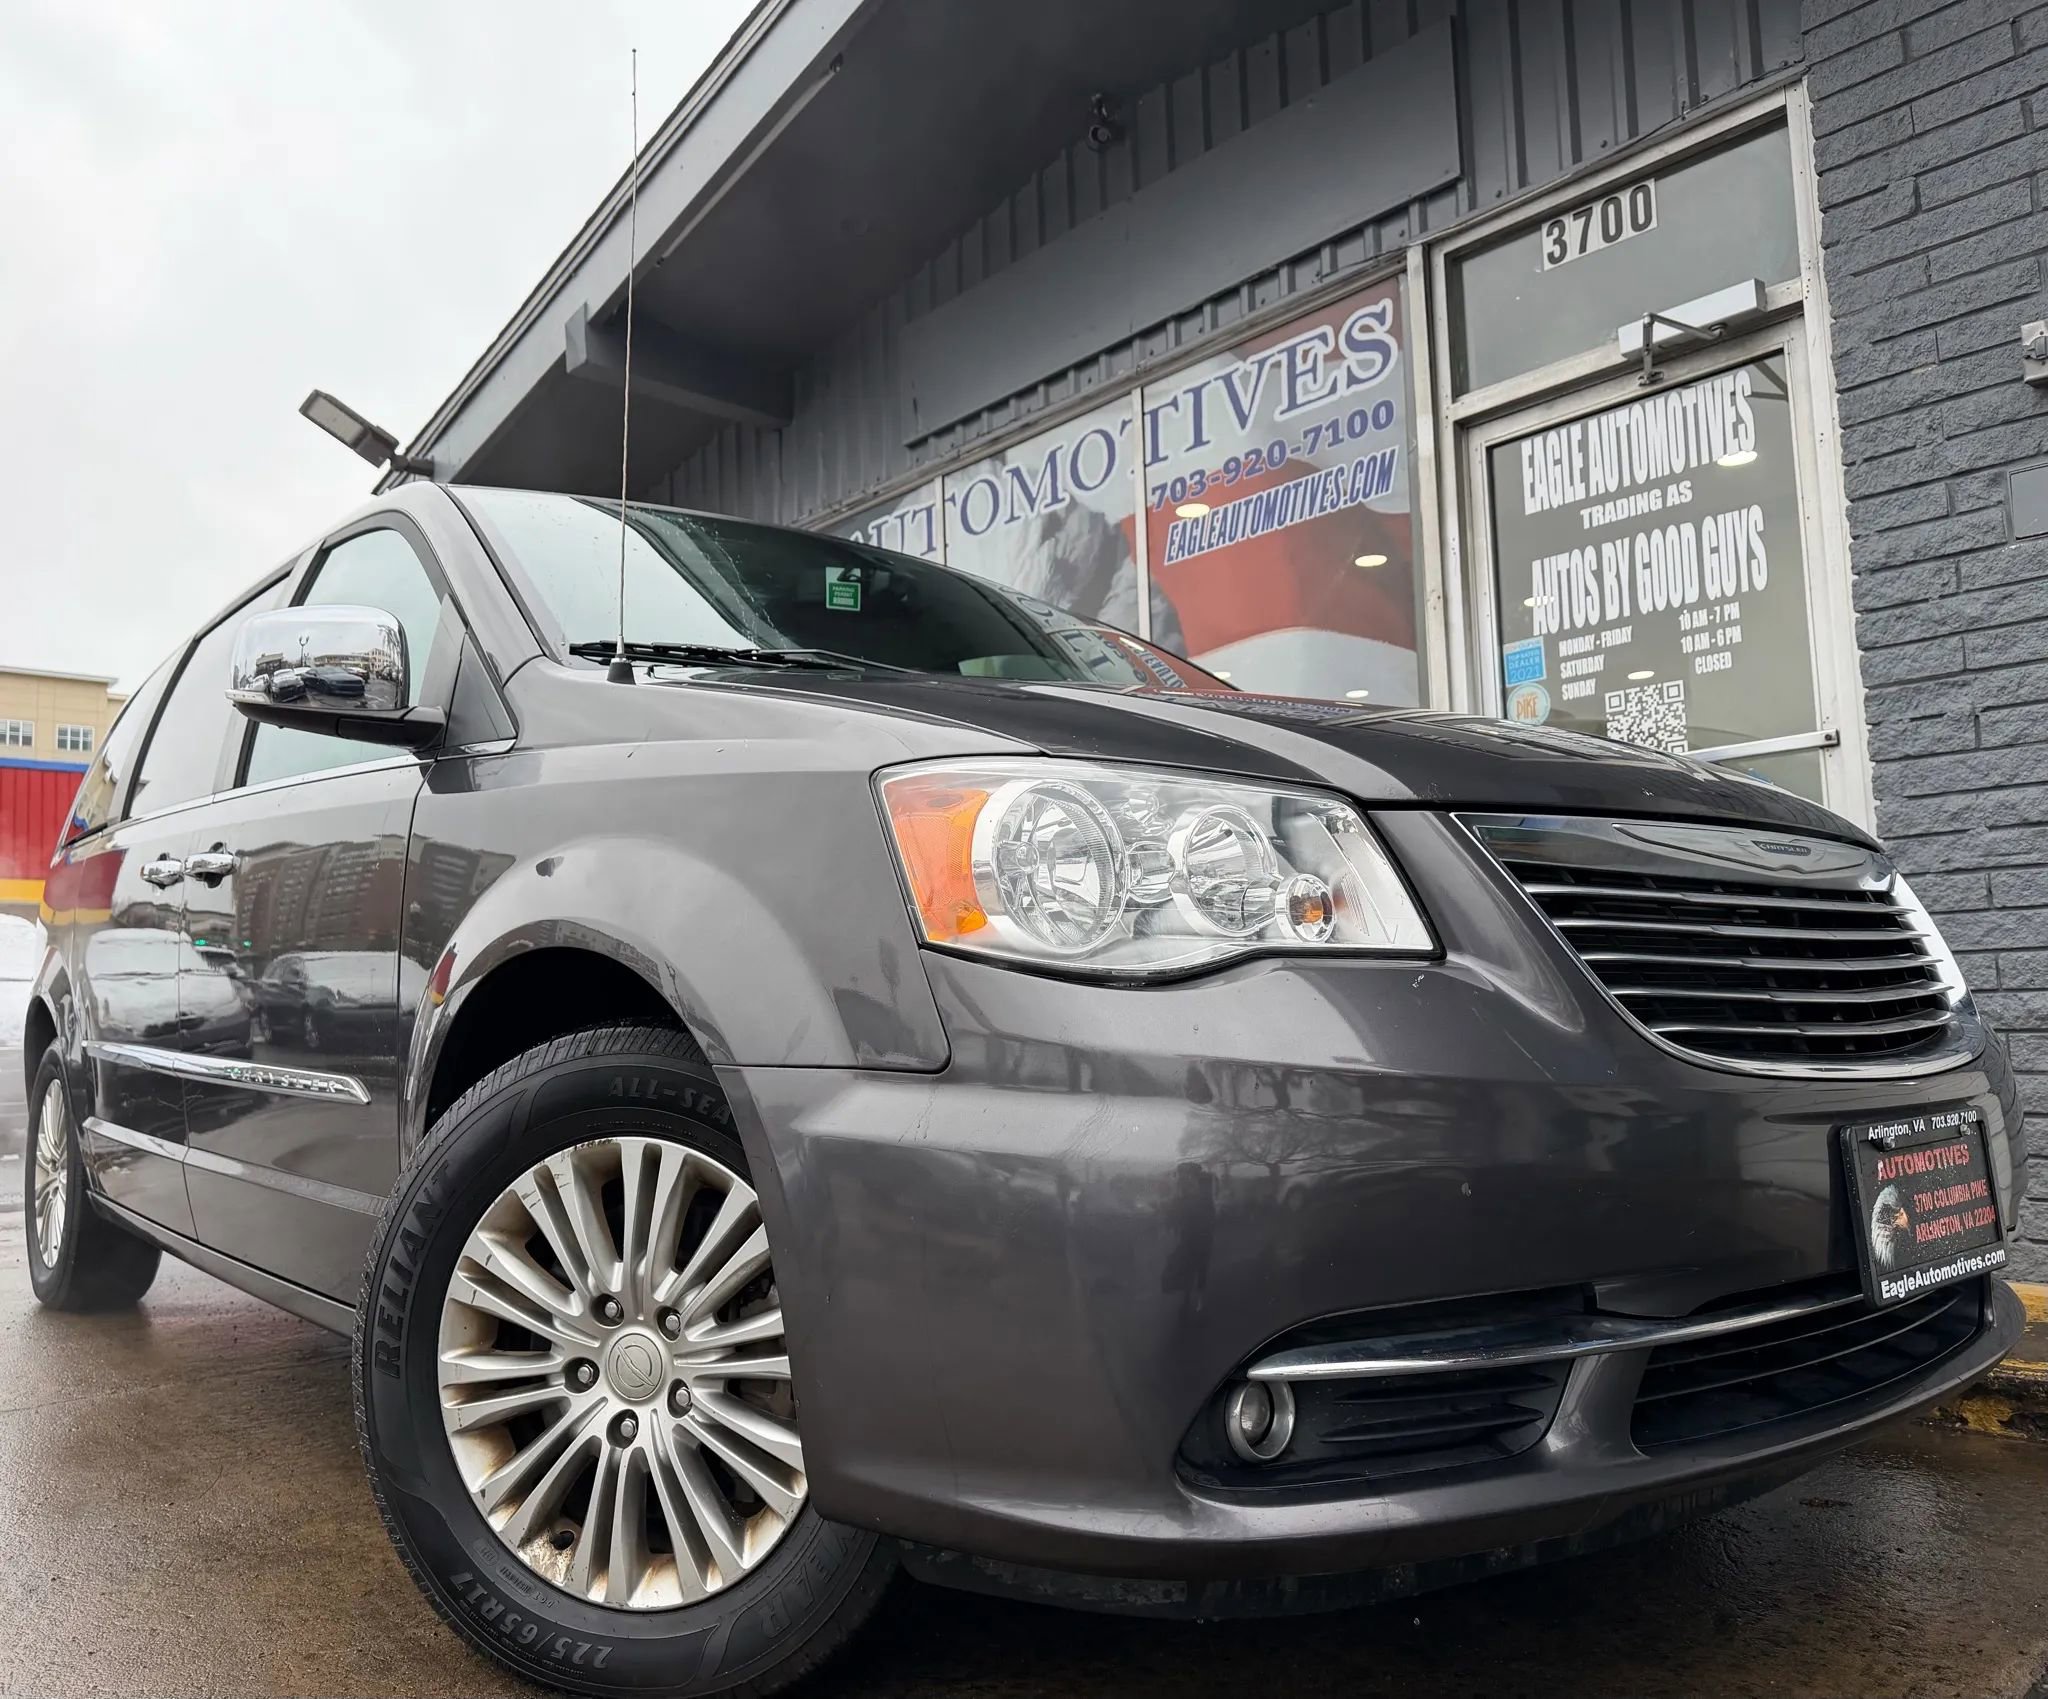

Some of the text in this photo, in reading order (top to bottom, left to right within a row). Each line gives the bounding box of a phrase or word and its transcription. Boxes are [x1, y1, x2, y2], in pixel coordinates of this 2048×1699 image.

[1544, 183, 1654, 266] 3700
[849, 298, 1398, 558] UTOMOTIVES
[1521, 370, 1757, 515] EAGLE AUTOMOTIVES
[1150, 399, 1396, 512] 703-920-7100
[1164, 446, 1399, 565] EAGLEAUTOMOTIVES.COM
[1580, 480, 1693, 529] TRADING AS
[1532, 504, 1768, 636] AUTOS BY GOOD GUYS
[1678, 612, 1691, 631] 10
[1691, 607, 1708, 628] AM
[1714, 605, 1722, 623] 7
[1723, 602, 1740, 622] PM
[1559, 635, 1595, 658] MONDAY
[1601, 626, 1632, 651] FRIDAY
[1681, 635, 1693, 654] 10
[1694, 630, 1710, 651] AM
[1716, 629, 1725, 645] 6
[1726, 625, 1742, 644] PM
[1560, 654, 1605, 679] SATURDAY
[1695, 651, 1732, 675] CLOSED
[1561, 678, 1596, 701] SUNDAY
[1868, 1110, 1977, 1141] Arlington, VA 703.920.7100
[1877, 1143, 1970, 1180] AUTOMOTIVES
[1914, 1179, 1989, 1213] 3700 COLUMBIA PIKE
[1962, 1211, 1975, 1230] VA
[373, 1158, 455, 1379] RELIANT
[1881, 1248, 2006, 1300] EagleAutomotives.com
[447, 1571, 613, 1670] 225/65R17
